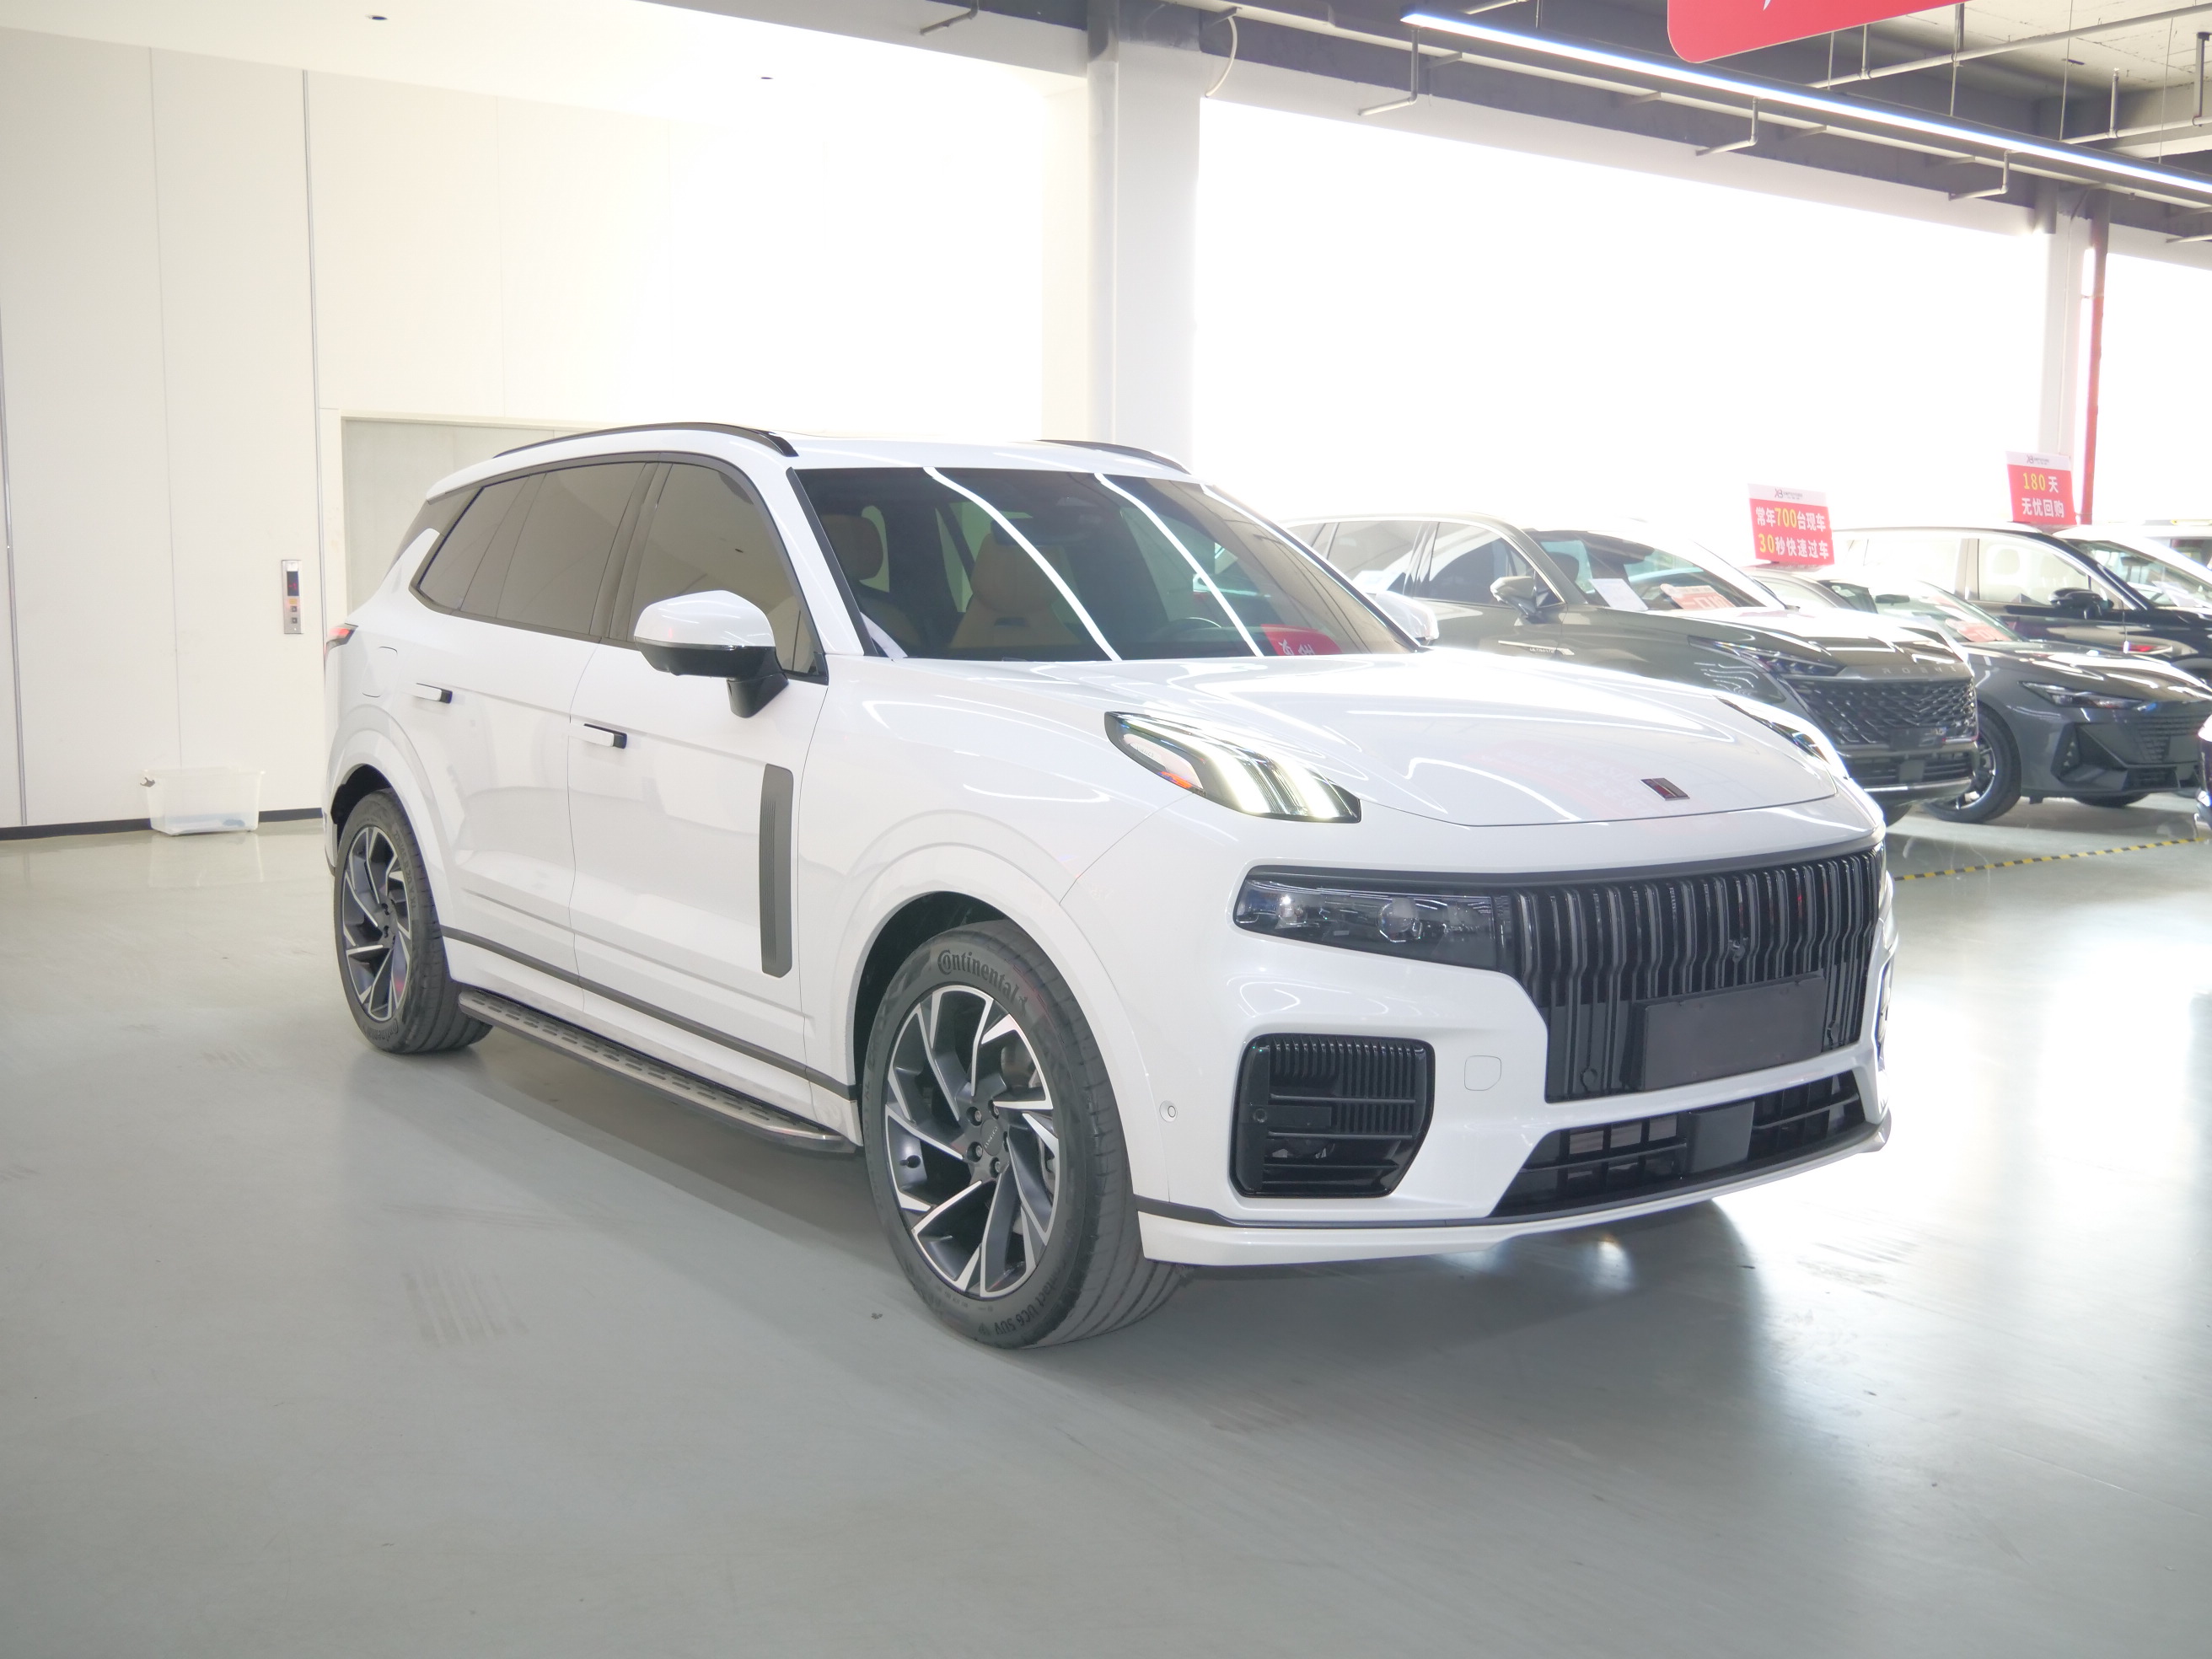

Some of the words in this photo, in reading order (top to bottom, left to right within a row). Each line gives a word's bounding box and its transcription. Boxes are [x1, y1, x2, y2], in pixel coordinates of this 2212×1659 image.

[2023, 472, 2059, 493] 180天
[1755, 506, 1826, 532] 常年700台现车
[2021, 497, 2064, 518] 无忧回购
[1758, 533, 1829, 559] 30秒快速过车
[937, 948, 1020, 1004] Continental
[994, 1318, 1017, 1335] SUV
